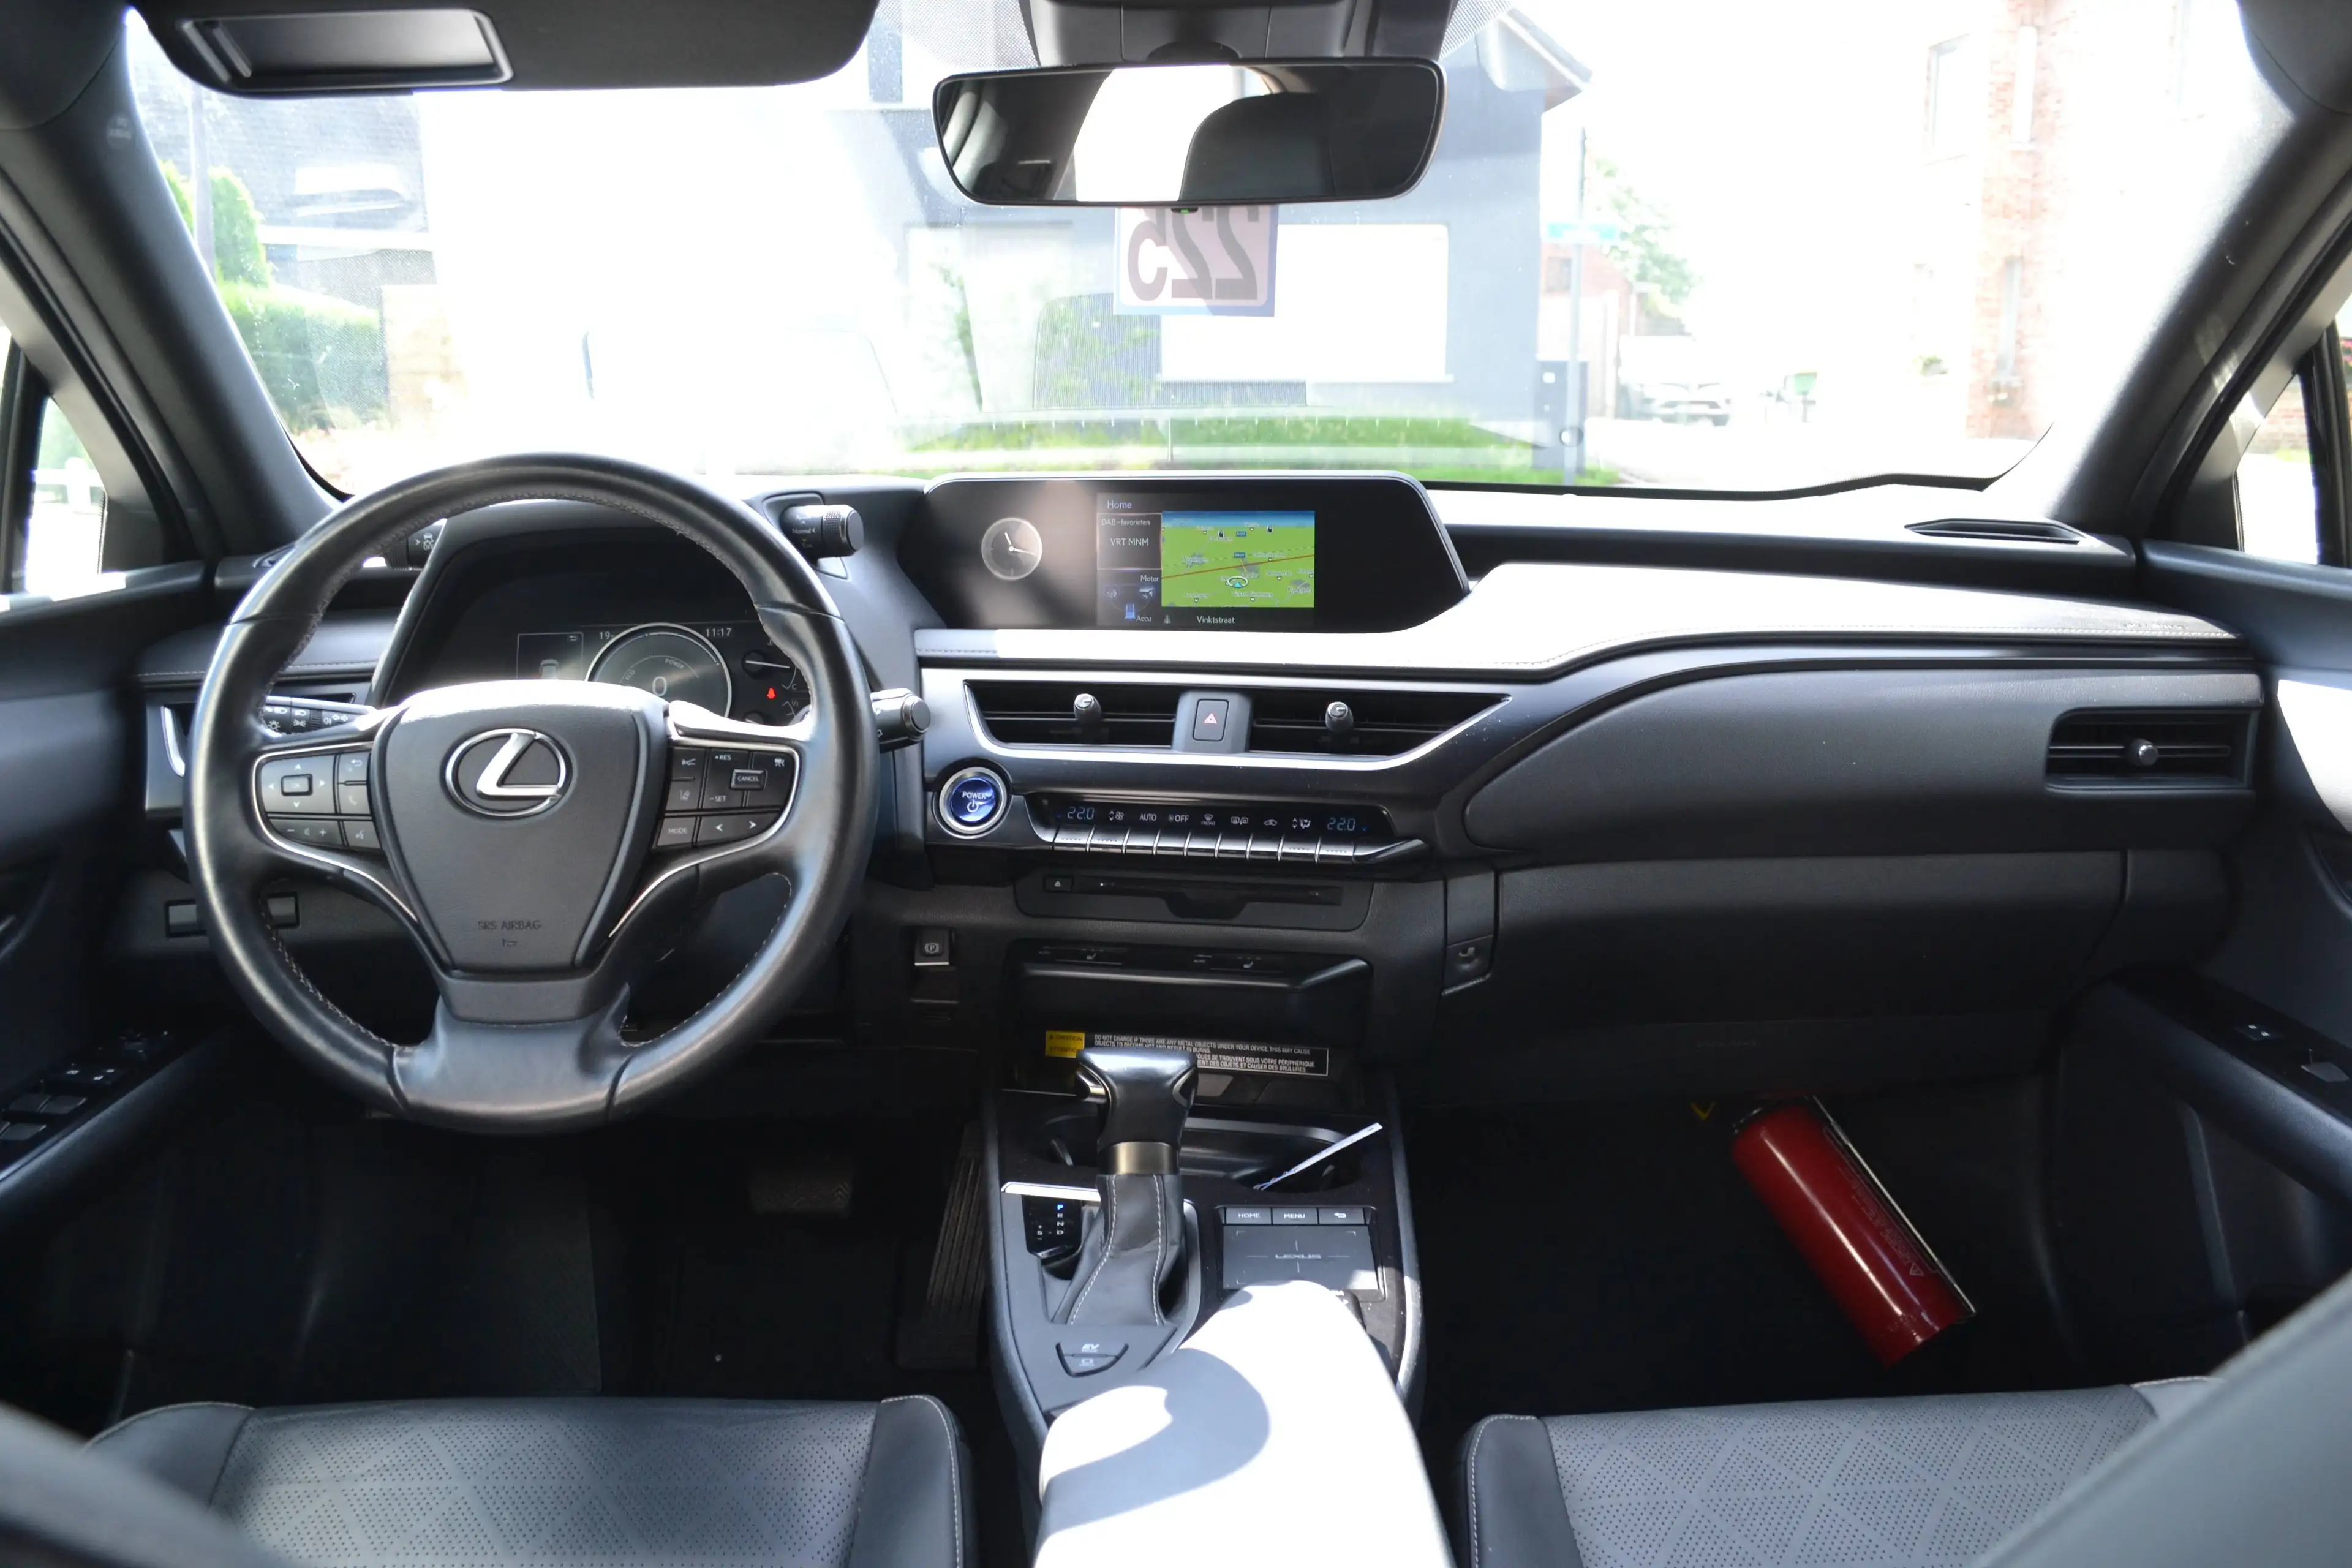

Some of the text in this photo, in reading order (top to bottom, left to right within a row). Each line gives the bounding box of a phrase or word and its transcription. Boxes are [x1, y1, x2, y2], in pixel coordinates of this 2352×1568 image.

[1107, 500, 1132, 509] Home
[1110, 538, 1149, 546] VRT MNM
[1196, 615, 1235, 624] Vinktstraat
[706, 627, 732, 638] 11:17
[665, 658, 685, 669] POWER
[962, 791, 987, 800] POWER
[1174, 815, 1189, 823] OFF
[500, 920, 541, 930] AIRBAG
